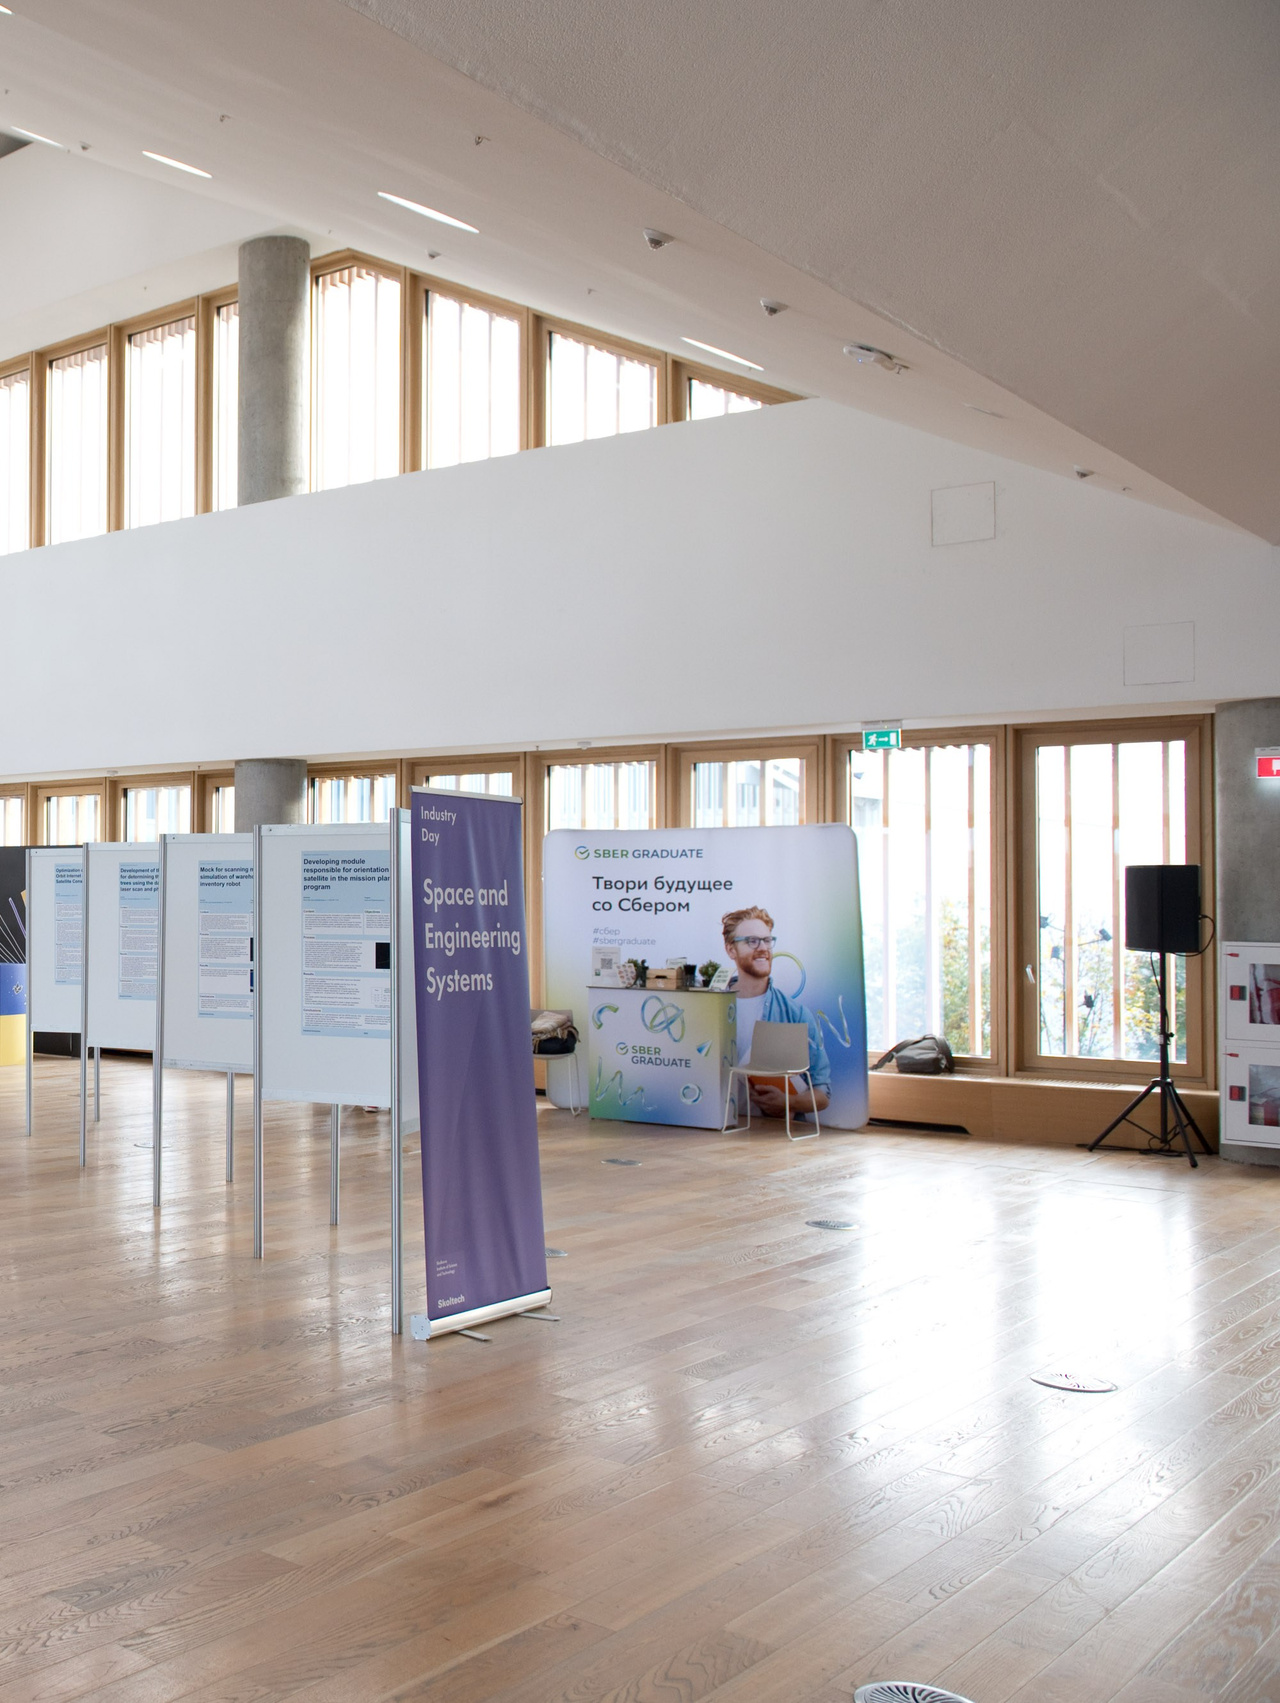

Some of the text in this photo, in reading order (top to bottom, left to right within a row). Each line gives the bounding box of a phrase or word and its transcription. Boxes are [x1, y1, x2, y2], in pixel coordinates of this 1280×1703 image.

[421, 806, 456, 826] Industry
[422, 828, 440, 846] Day
[594, 848, 704, 859] SBER GRADUATE
[303, 858, 340, 866] Developing
[592, 875, 733, 894] Твори будущее
[423, 878, 508, 912] Space and
[592, 897, 690, 915] со Сбером
[425, 922, 520, 956] Engineering
[592, 926, 620, 936] #сбер
[592, 937, 656, 946] #sbergraduate
[426, 966, 494, 1001] Systems
[631, 1045, 661, 1055] SBER
[631, 1055, 691, 1068] GRADUATE
[437, 1294, 465, 1309] Skoltech
